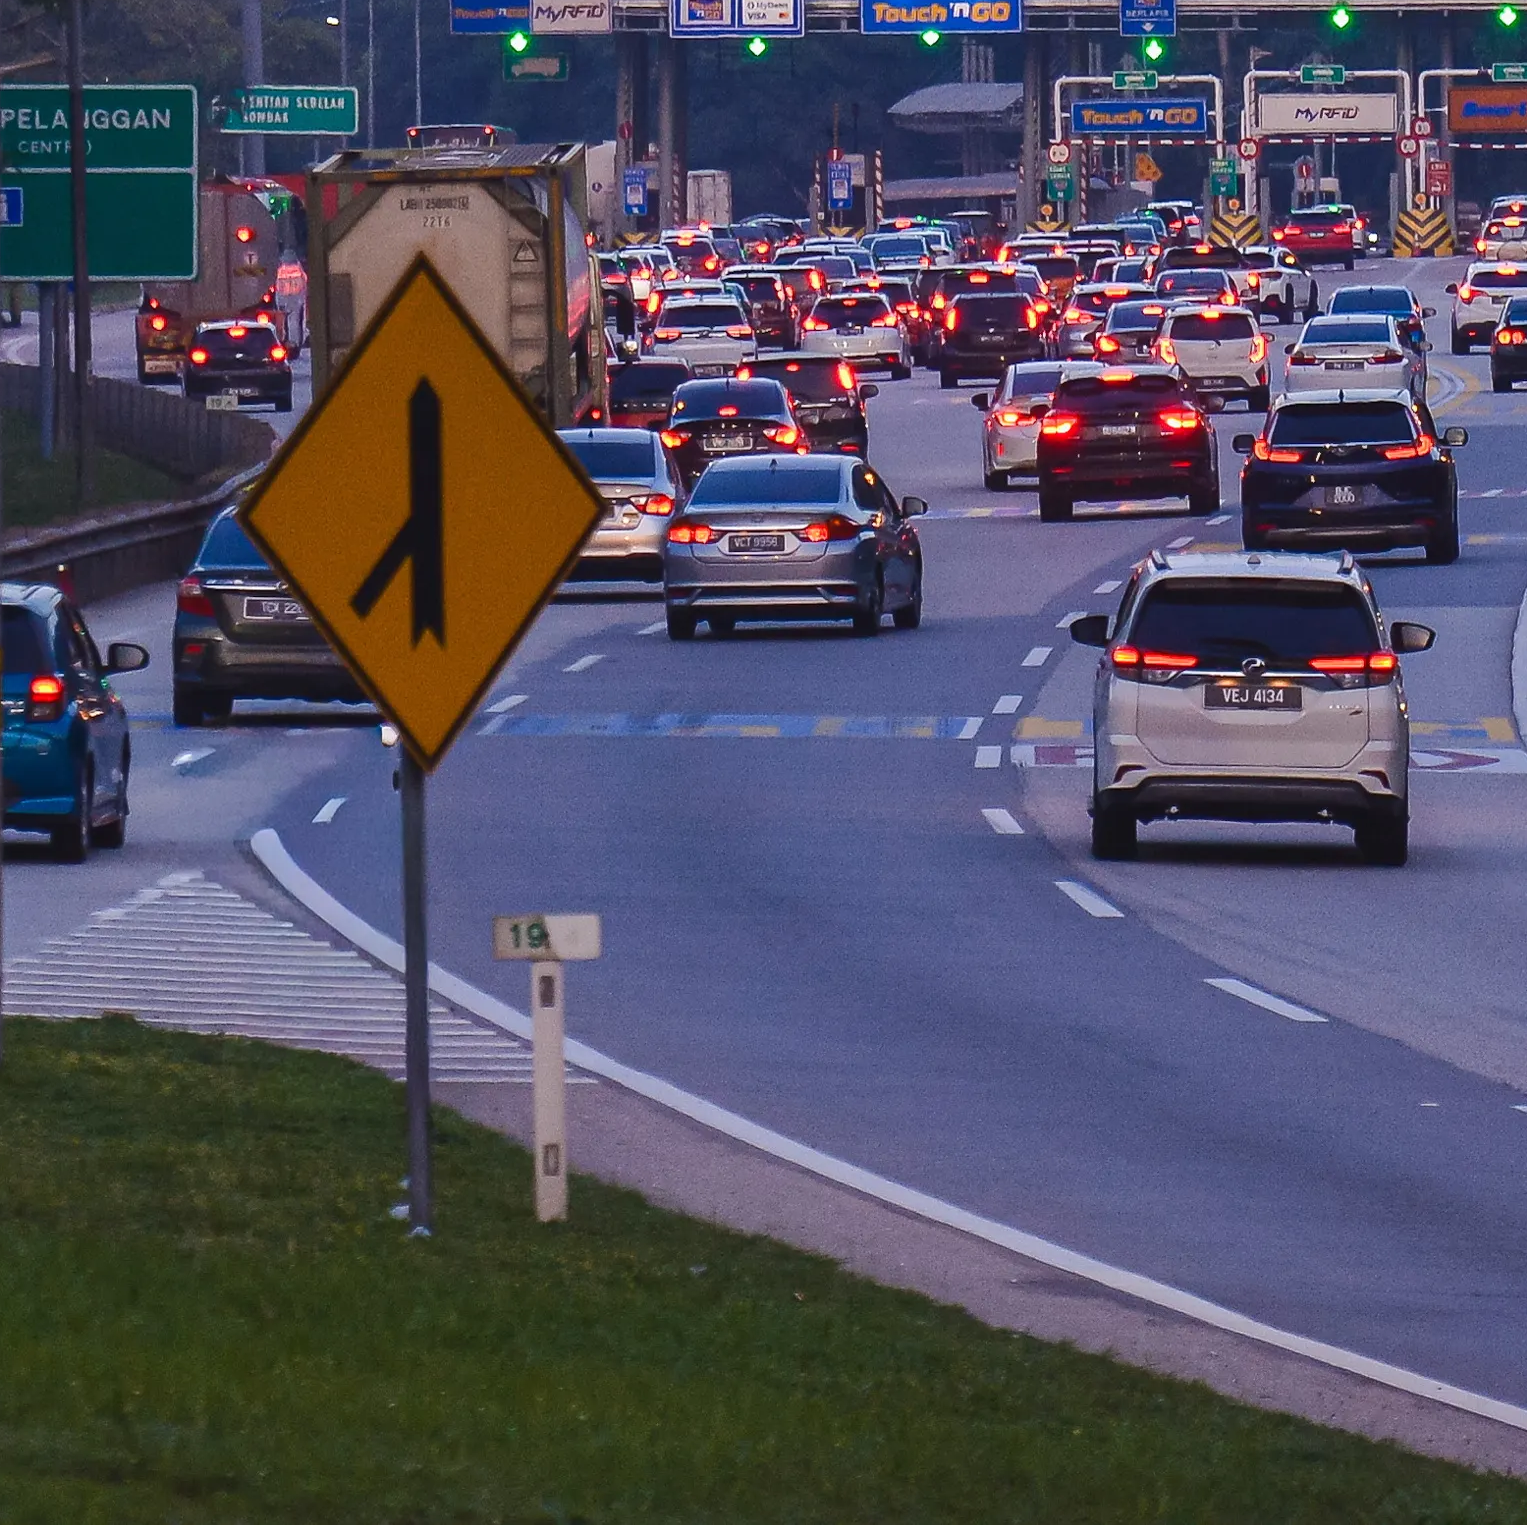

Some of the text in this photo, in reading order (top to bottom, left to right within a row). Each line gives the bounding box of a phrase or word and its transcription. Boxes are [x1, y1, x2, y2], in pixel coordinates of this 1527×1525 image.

[873, 2, 947, 22] Touch
[1081, 109, 1144, 124] Touch
[734, 536, 751, 547] VCT
[1222, 688, 1285, 703] VEJ 4134
